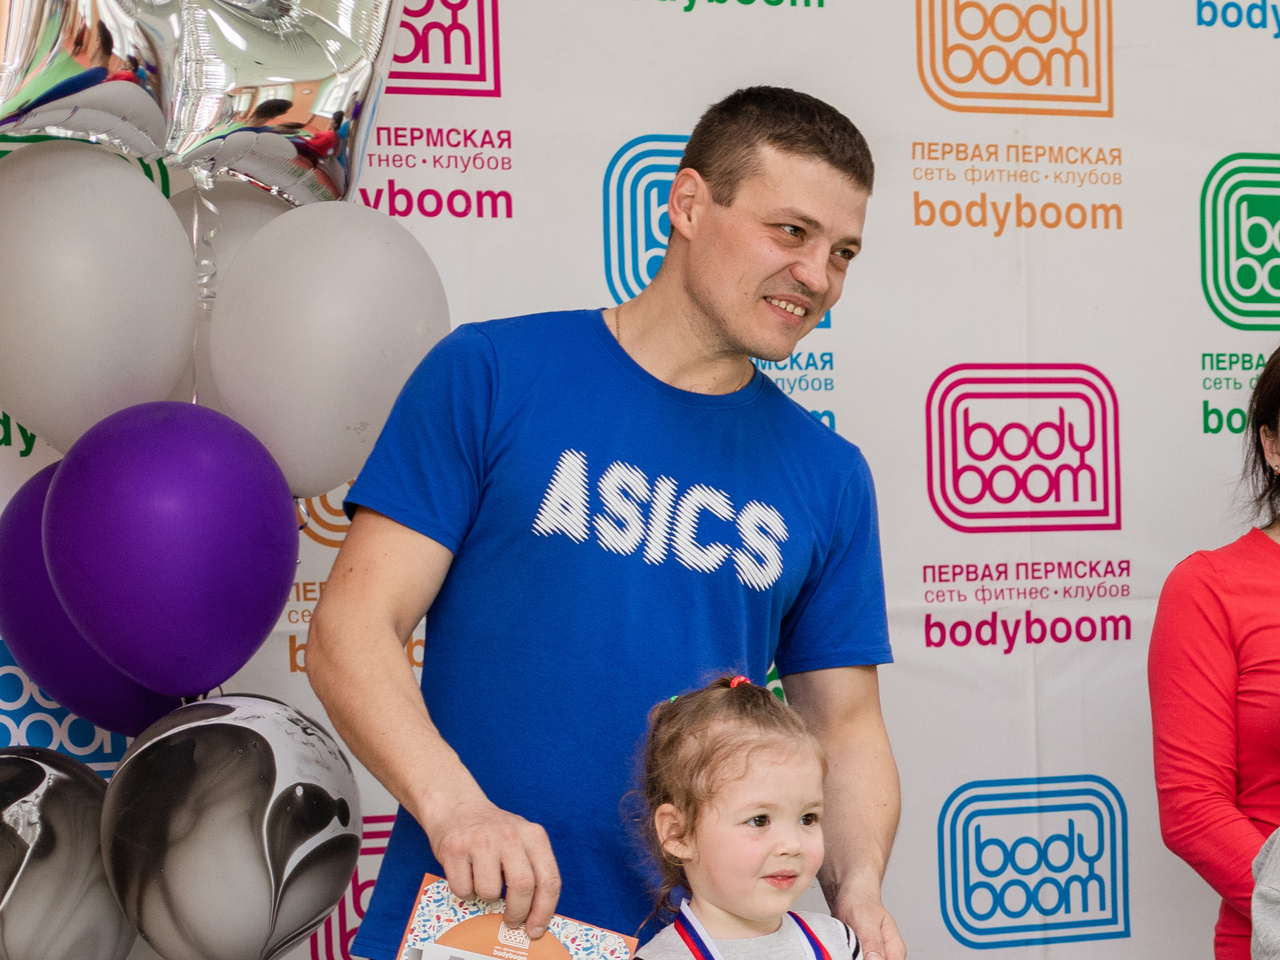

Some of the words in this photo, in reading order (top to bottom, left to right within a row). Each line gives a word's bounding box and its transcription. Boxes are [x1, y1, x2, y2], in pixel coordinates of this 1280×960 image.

[393, 20, 472, 65] om
[953, 0, 1088, 48] body
[943, 43, 1089, 88] boom
[376, 127, 513, 149] ПЕРМСКАЯ
[911, 141, 999, 162] ПЕРВАЯ
[1006, 145, 1122, 166] ПЕРМСКАЯ
[912, 166, 957, 182] сеть
[358, 179, 513, 219] yboom
[913, 191, 1123, 238] bodyboom
[1202, 353, 1272, 371] ПЕРВА
[1202, 377, 1242, 390] сеть
[963, 406, 1095, 464] body
[952, 464, 1097, 504] boom
[532, 449, 788, 592] ASICS
[922, 563, 1008, 583] ПЕРВАЯ
[1015, 560, 1131, 581] ПЕРМСКАЯ
[924, 588, 967, 603] сеть
[924, 610, 1131, 655] bodyboom
[974, 818, 1105, 878] body
[964, 875, 1106, 921] boom
